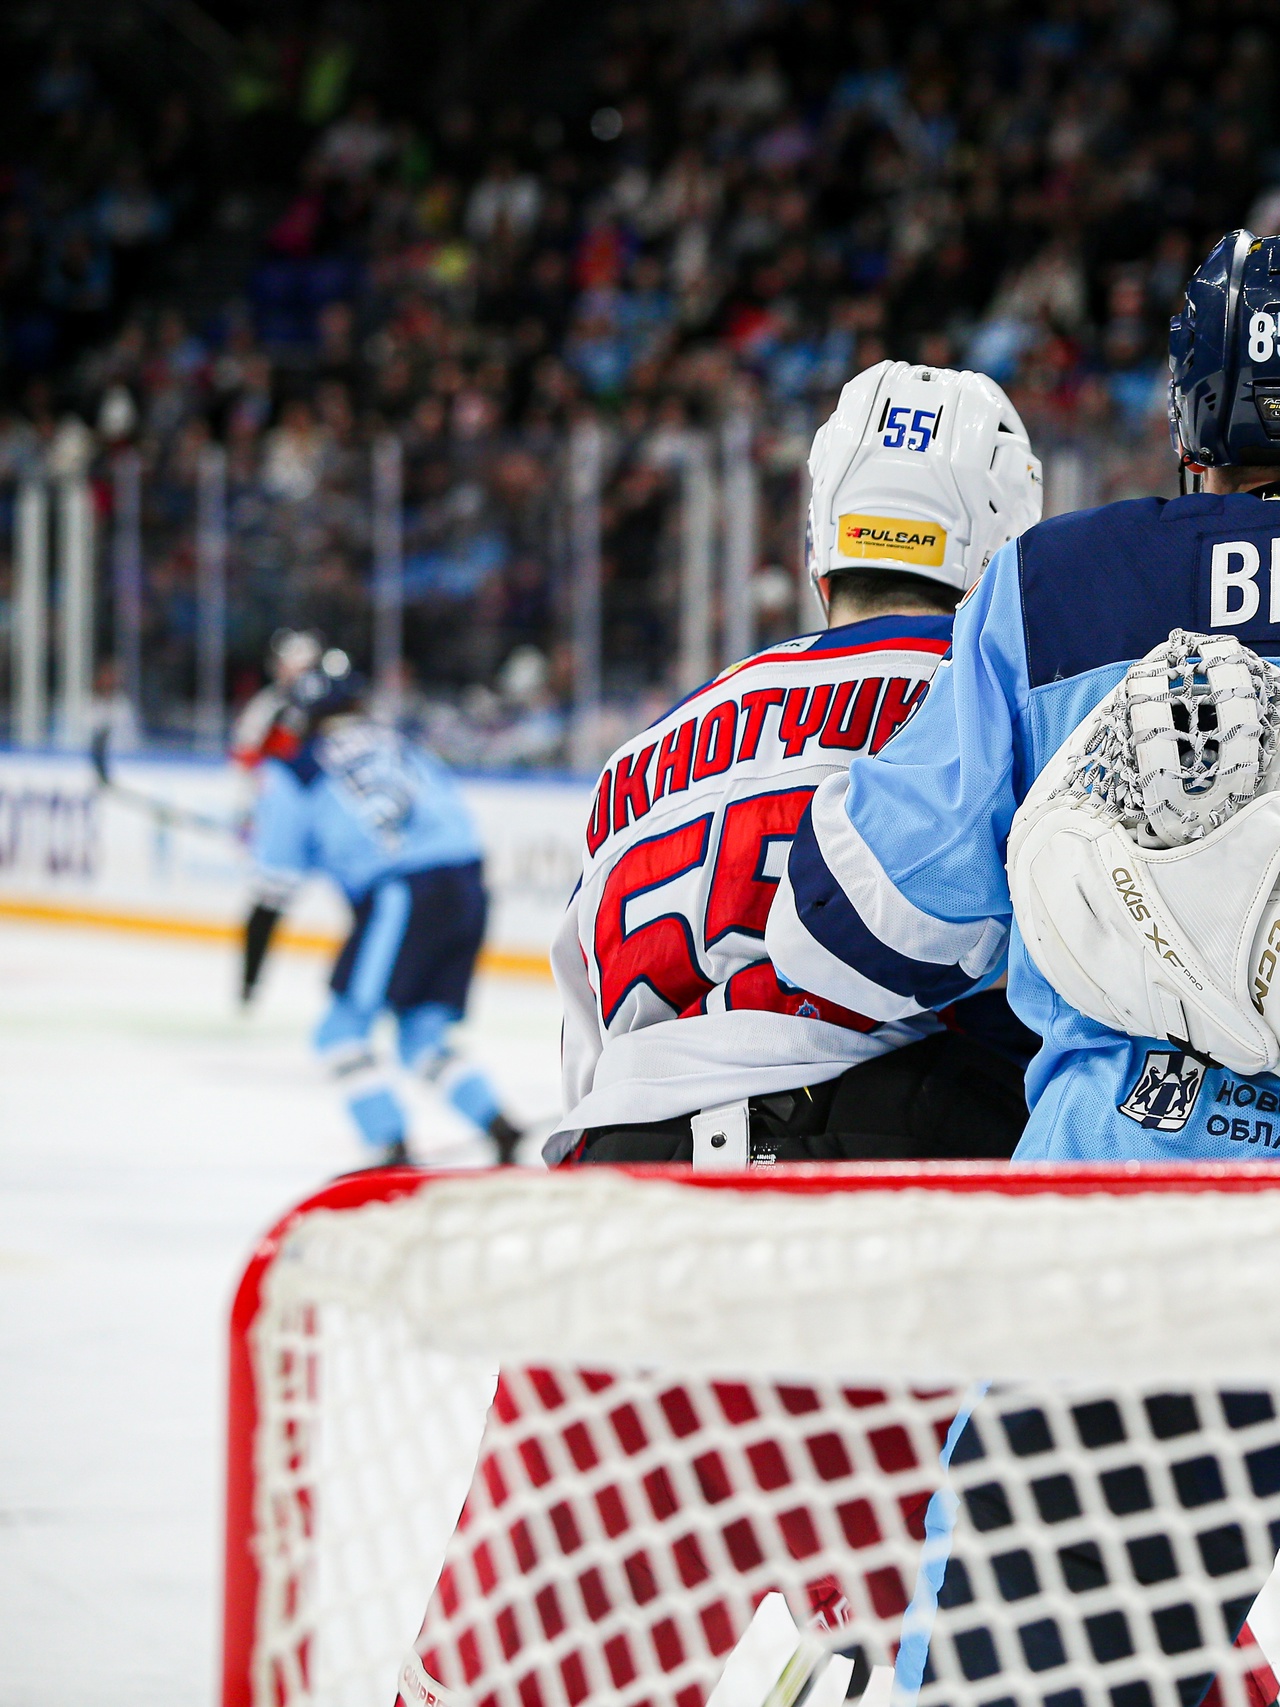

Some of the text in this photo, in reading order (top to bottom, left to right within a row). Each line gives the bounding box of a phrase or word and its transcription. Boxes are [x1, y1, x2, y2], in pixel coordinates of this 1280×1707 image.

[883, 406, 936, 452] 55
[858, 527, 937, 547] PULSAR
[587, 676, 930, 858] OKHOTYUK
[593, 783, 884, 1034] 55
[1144, 922, 1185, 968] XF
[1183, 968, 1204, 991] PRO
